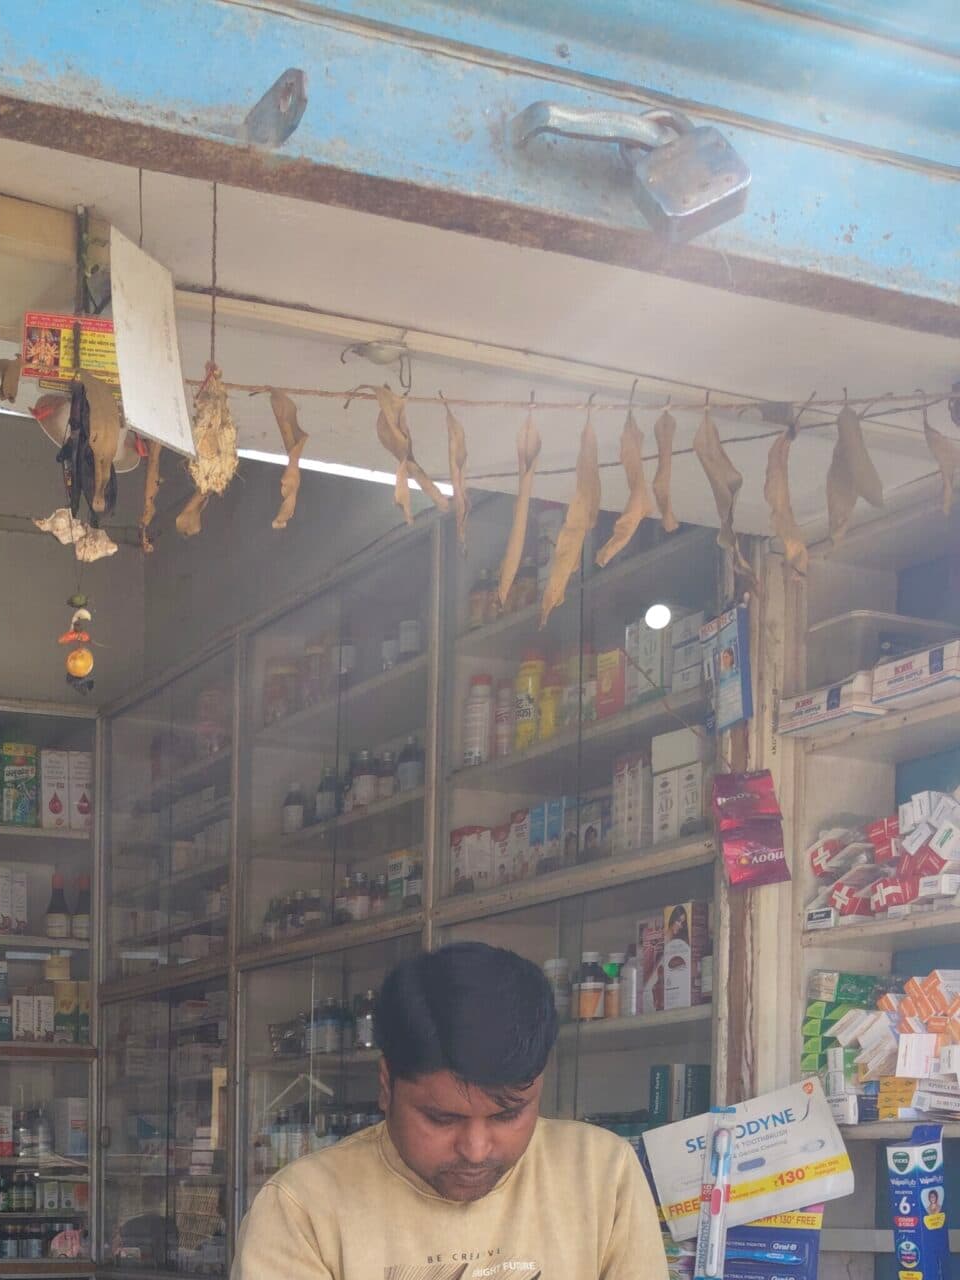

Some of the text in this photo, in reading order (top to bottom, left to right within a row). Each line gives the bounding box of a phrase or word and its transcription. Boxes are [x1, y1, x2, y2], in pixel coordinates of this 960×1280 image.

[686, 1108, 796, 1153] SEODYNE
[668, 1199, 700, 1217] FREE
[899, 1196, 911, 1215] 6
[796, 1216, 817, 1225] FREE
[773, 1242, 797, 1250] Oral-B
[427, 1254, 441, 1264] BE
